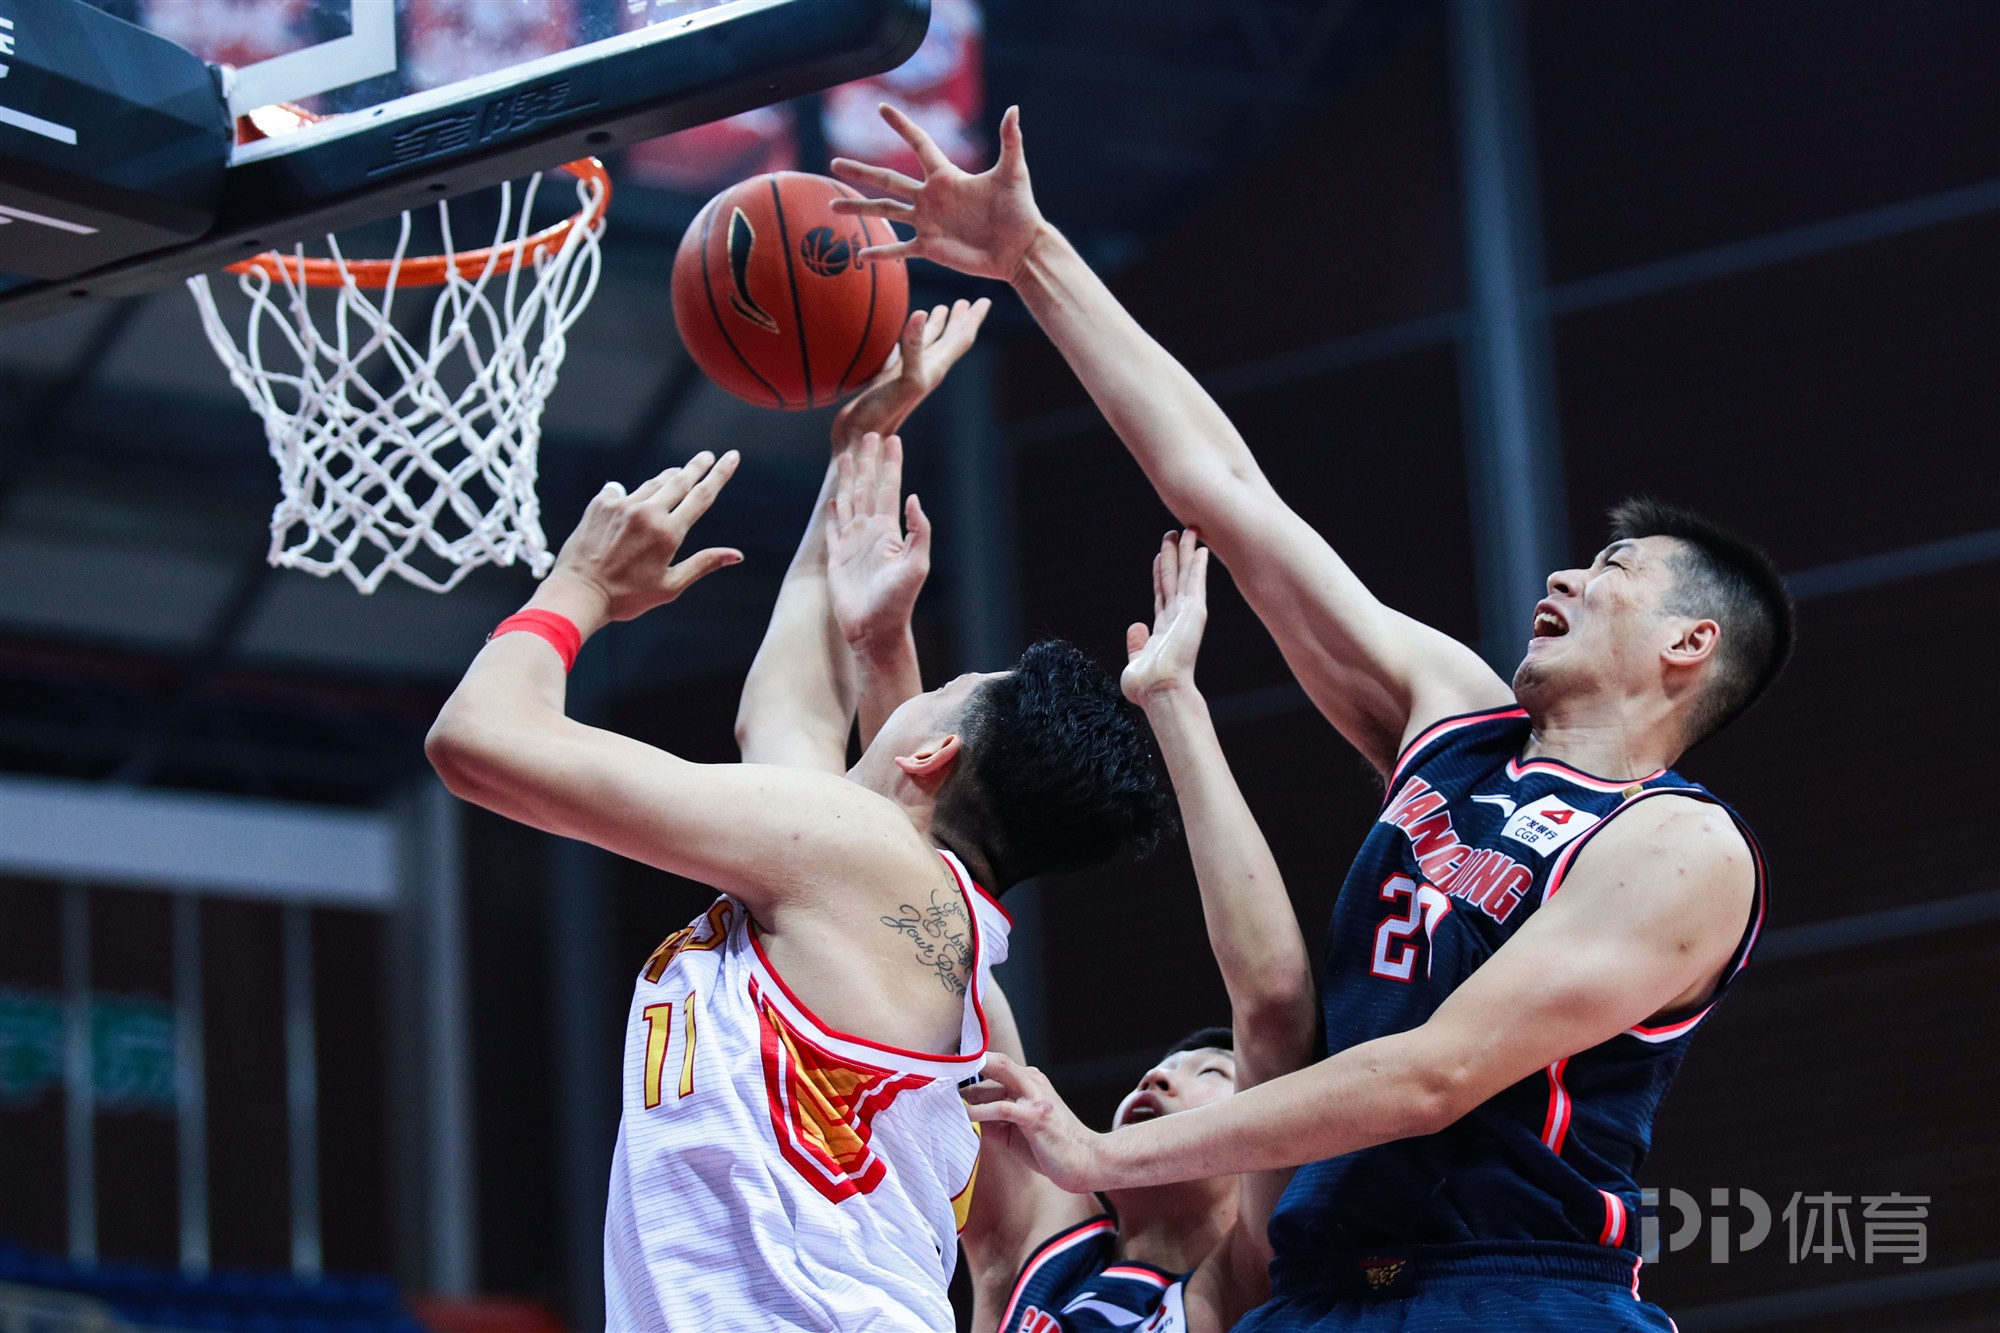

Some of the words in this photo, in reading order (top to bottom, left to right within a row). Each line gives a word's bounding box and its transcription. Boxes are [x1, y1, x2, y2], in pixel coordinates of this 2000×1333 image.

[1514, 827, 1540, 844] CGB
[1517, 815, 1558, 841] 广发银行
[880, 903, 935, 959] Your
[642, 990, 697, 1110] 11
